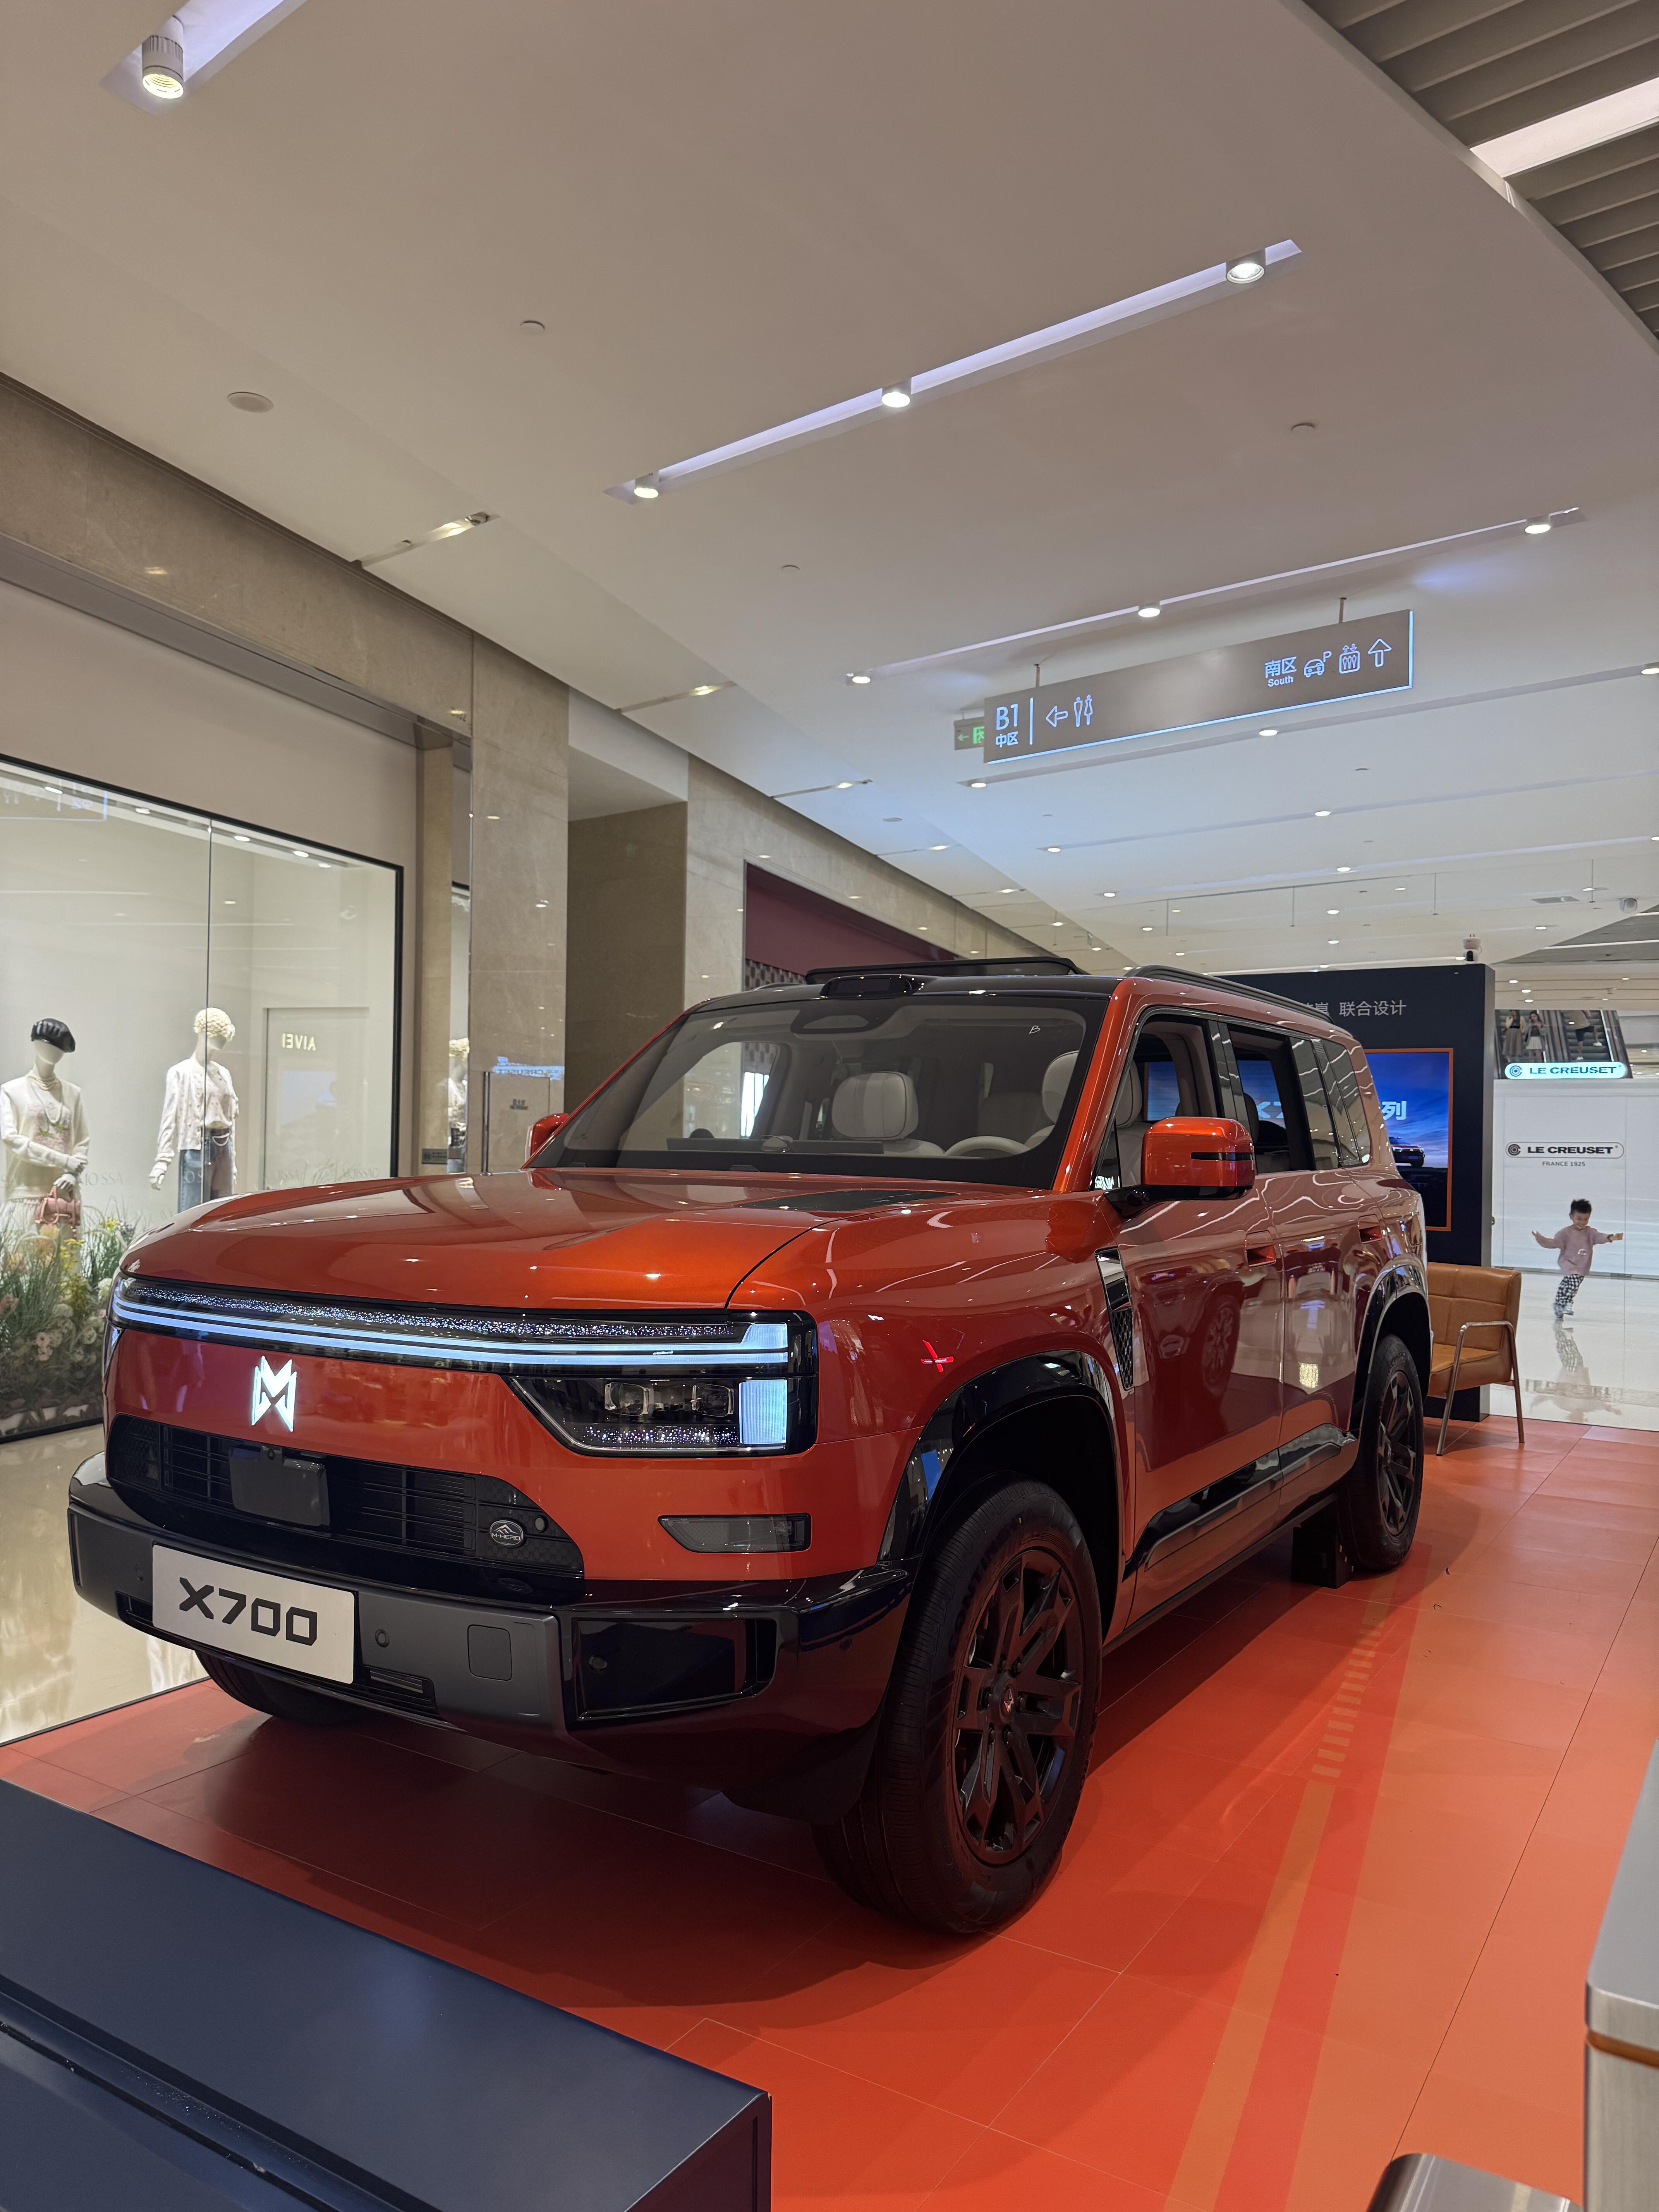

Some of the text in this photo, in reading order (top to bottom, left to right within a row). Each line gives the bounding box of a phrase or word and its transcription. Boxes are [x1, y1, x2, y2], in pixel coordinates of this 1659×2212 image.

[1264, 656, 1297, 678] 南区
[1268, 676, 1293, 687] South
[996, 703, 1019, 731] B1
[995, 731, 1019, 748] 中区
[1339, 1000, 1407, 1017] 联合设计
[491, 1532, 521, 1540] M-HERO
[179, 1577, 318, 1646] X700
